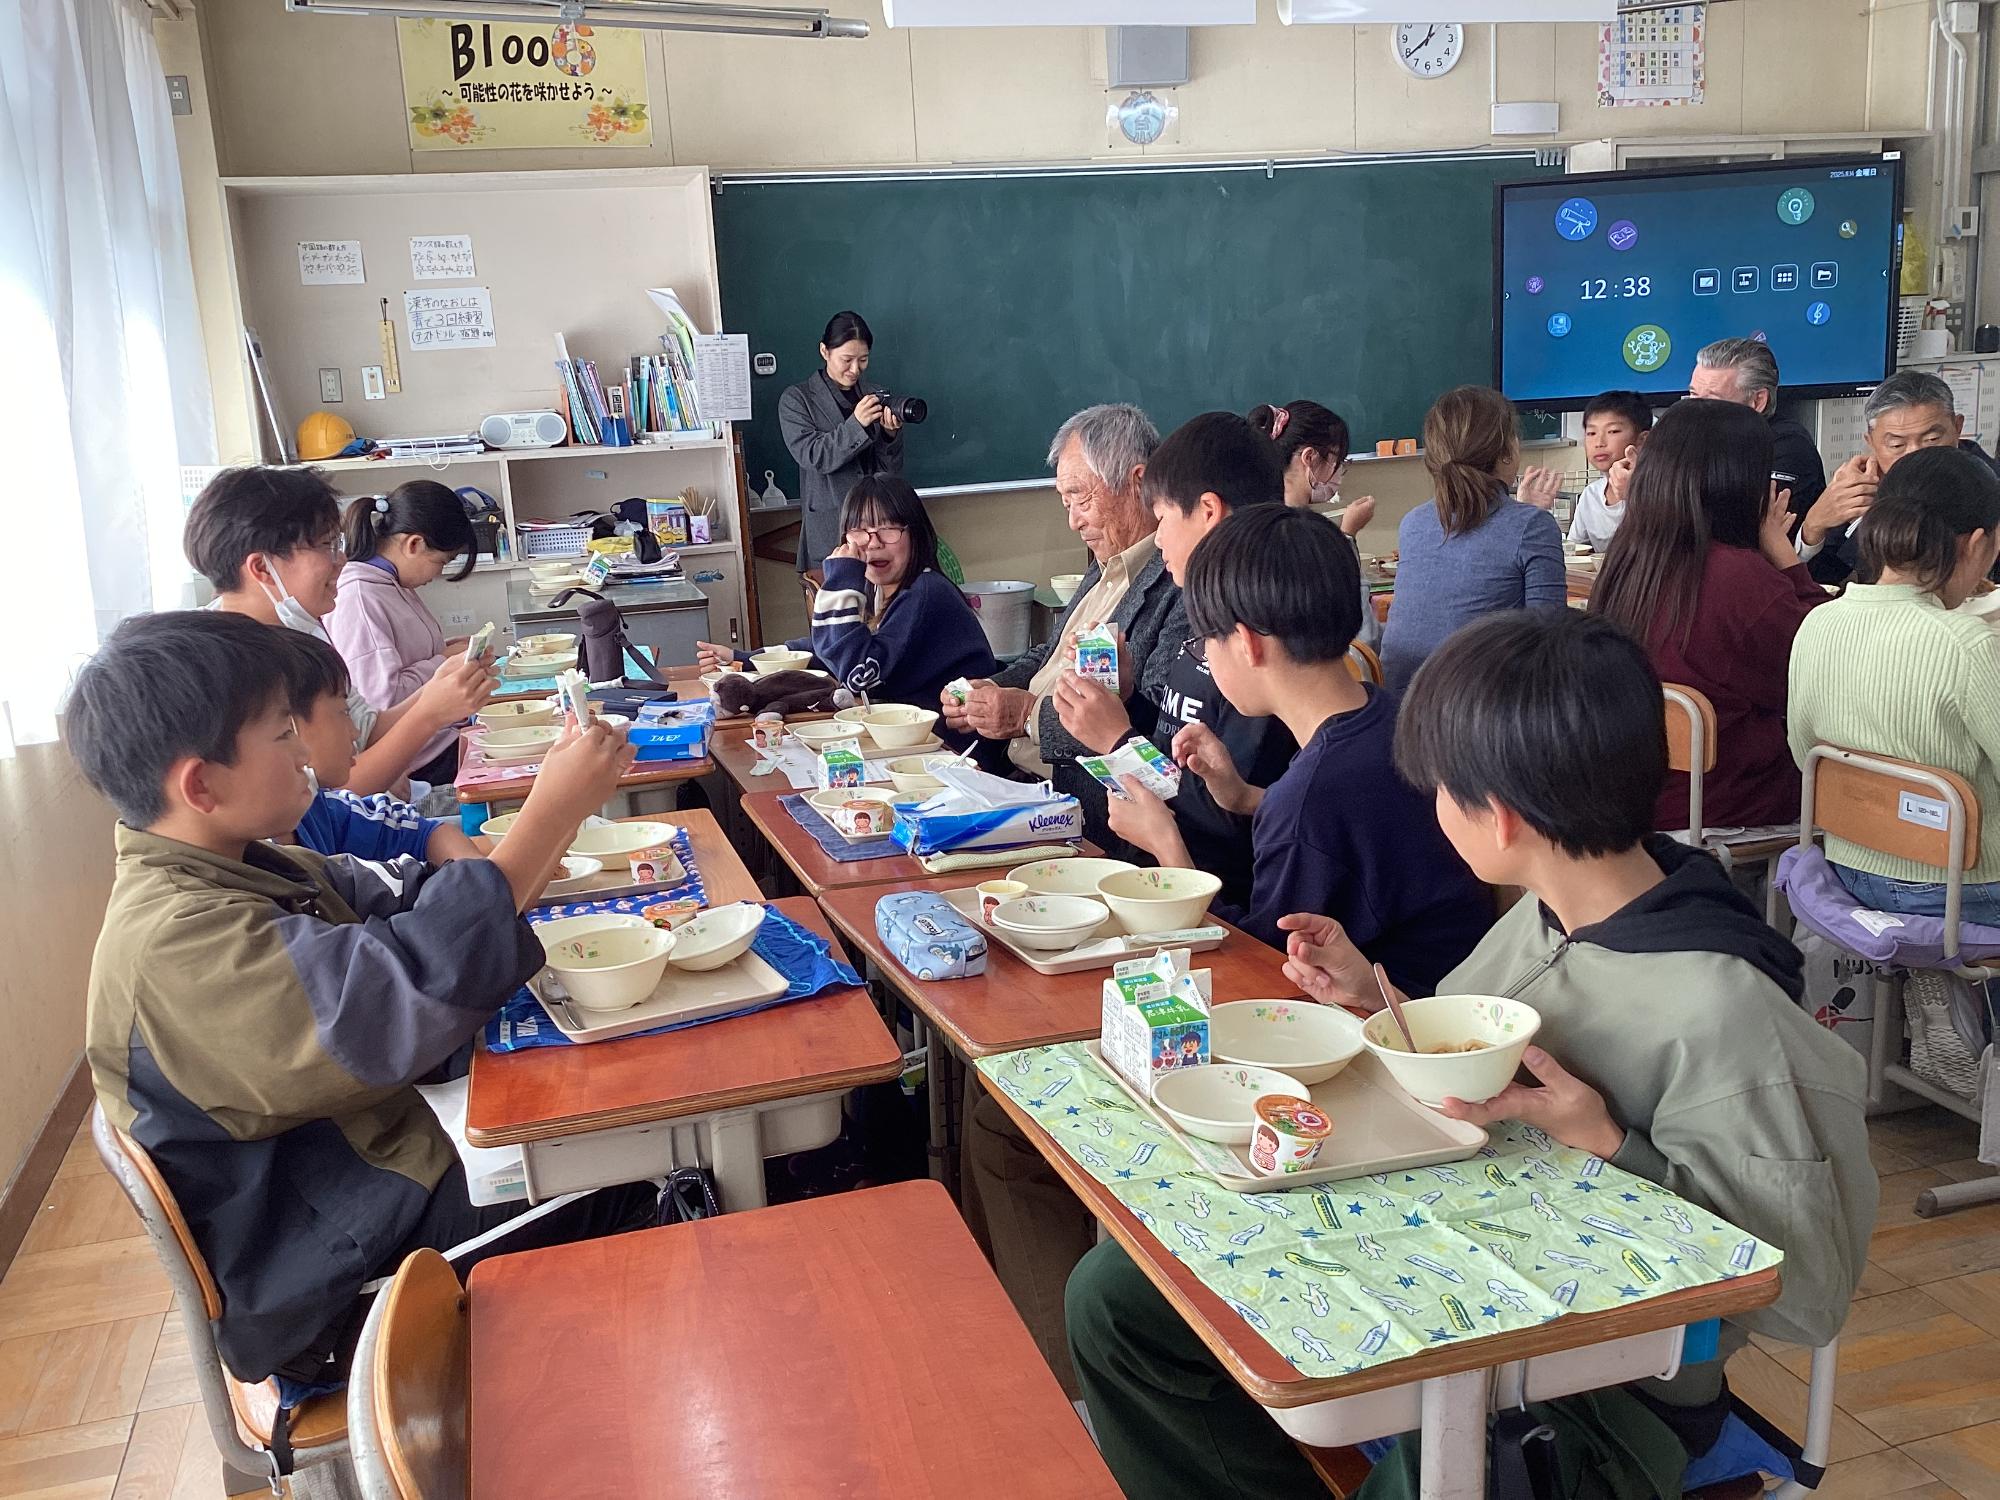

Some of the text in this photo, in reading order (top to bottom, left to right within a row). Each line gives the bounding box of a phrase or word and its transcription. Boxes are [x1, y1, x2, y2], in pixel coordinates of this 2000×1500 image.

[1402, 34, 1408, 43] 9
[1448, 34, 1454, 42] 3
[1444, 48, 1450, 56] 4
[1414, 58, 1419, 67] 7
[1424, 61, 1430, 70] 6
[1436, 58, 1442, 66] 5
[459, 82, 595, 103] 可能性の花を咲かせよう
[1855, 167, 1877, 177] 金曜日
[408, 296, 479, 311] 漢字のなおしは
[649, 734, 681, 742] エルモア
[1906, 801, 1913, 813] L
[1028, 814, 1074, 833] Kleenex
